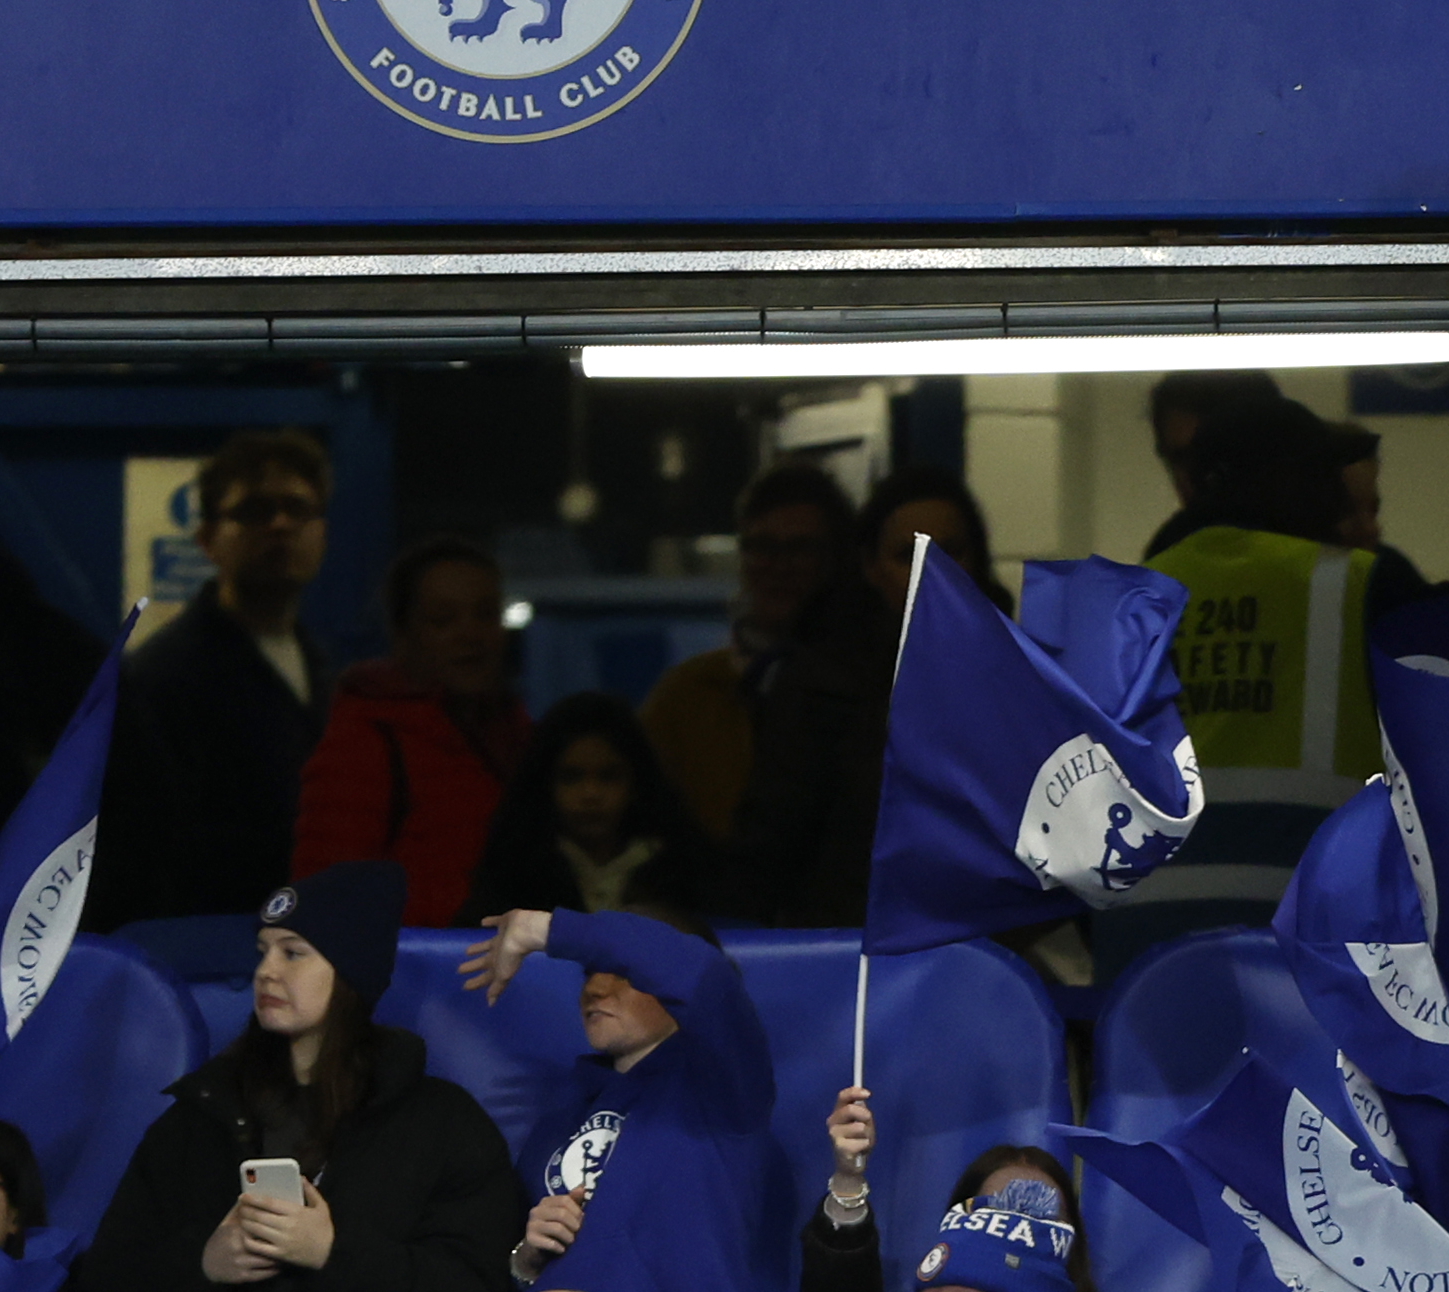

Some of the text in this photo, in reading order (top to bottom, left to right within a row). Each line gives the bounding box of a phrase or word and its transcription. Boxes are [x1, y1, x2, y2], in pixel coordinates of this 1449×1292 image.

[370, 45, 642, 120] FOOTBALL CLUB
[1180, 679, 1274, 714] EWARD
[1299, 1110, 1343, 1246] CHELSE
